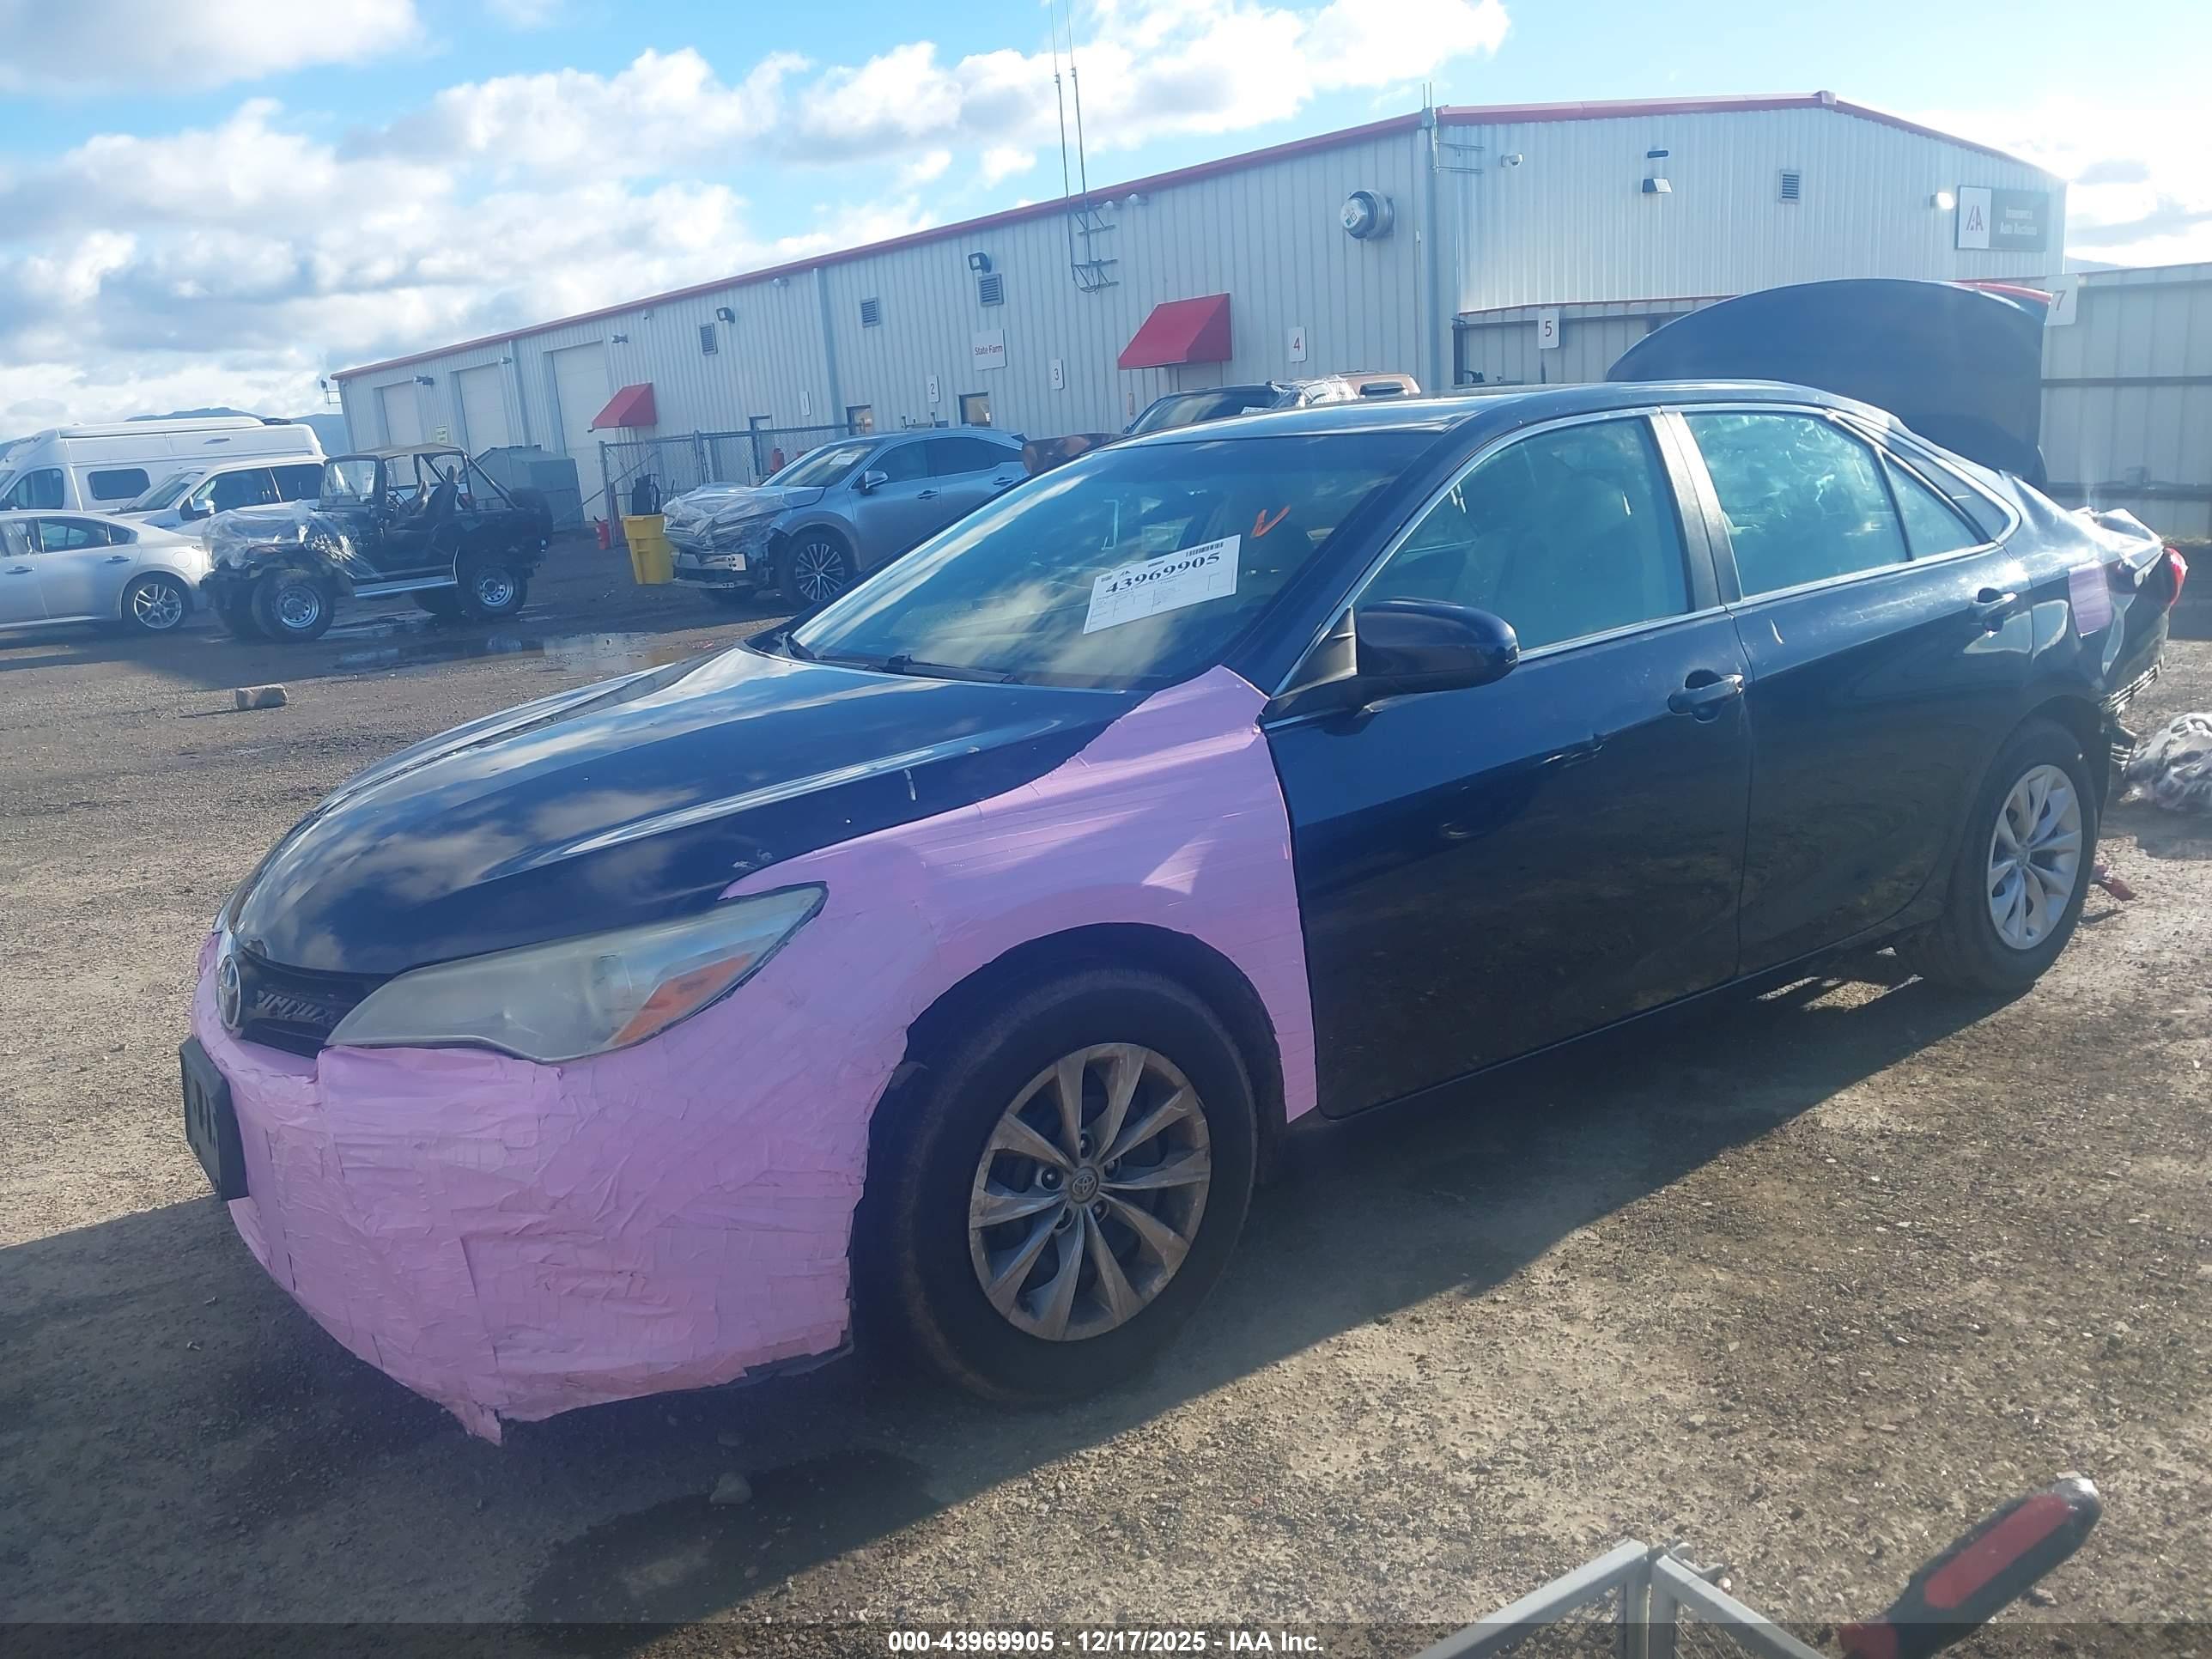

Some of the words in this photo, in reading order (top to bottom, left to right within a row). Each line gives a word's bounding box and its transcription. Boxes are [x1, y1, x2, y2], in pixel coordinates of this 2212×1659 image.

[2055, 289, 2067, 312] 7
[1545, 319, 1553, 337] 5
[988, 344, 1004, 354] Farm
[1293, 336, 1301, 351] 4
[1054, 368, 1060, 381] 3
[930, 383, 936, 395] 2
[1105, 551, 1221, 594] 43969905
